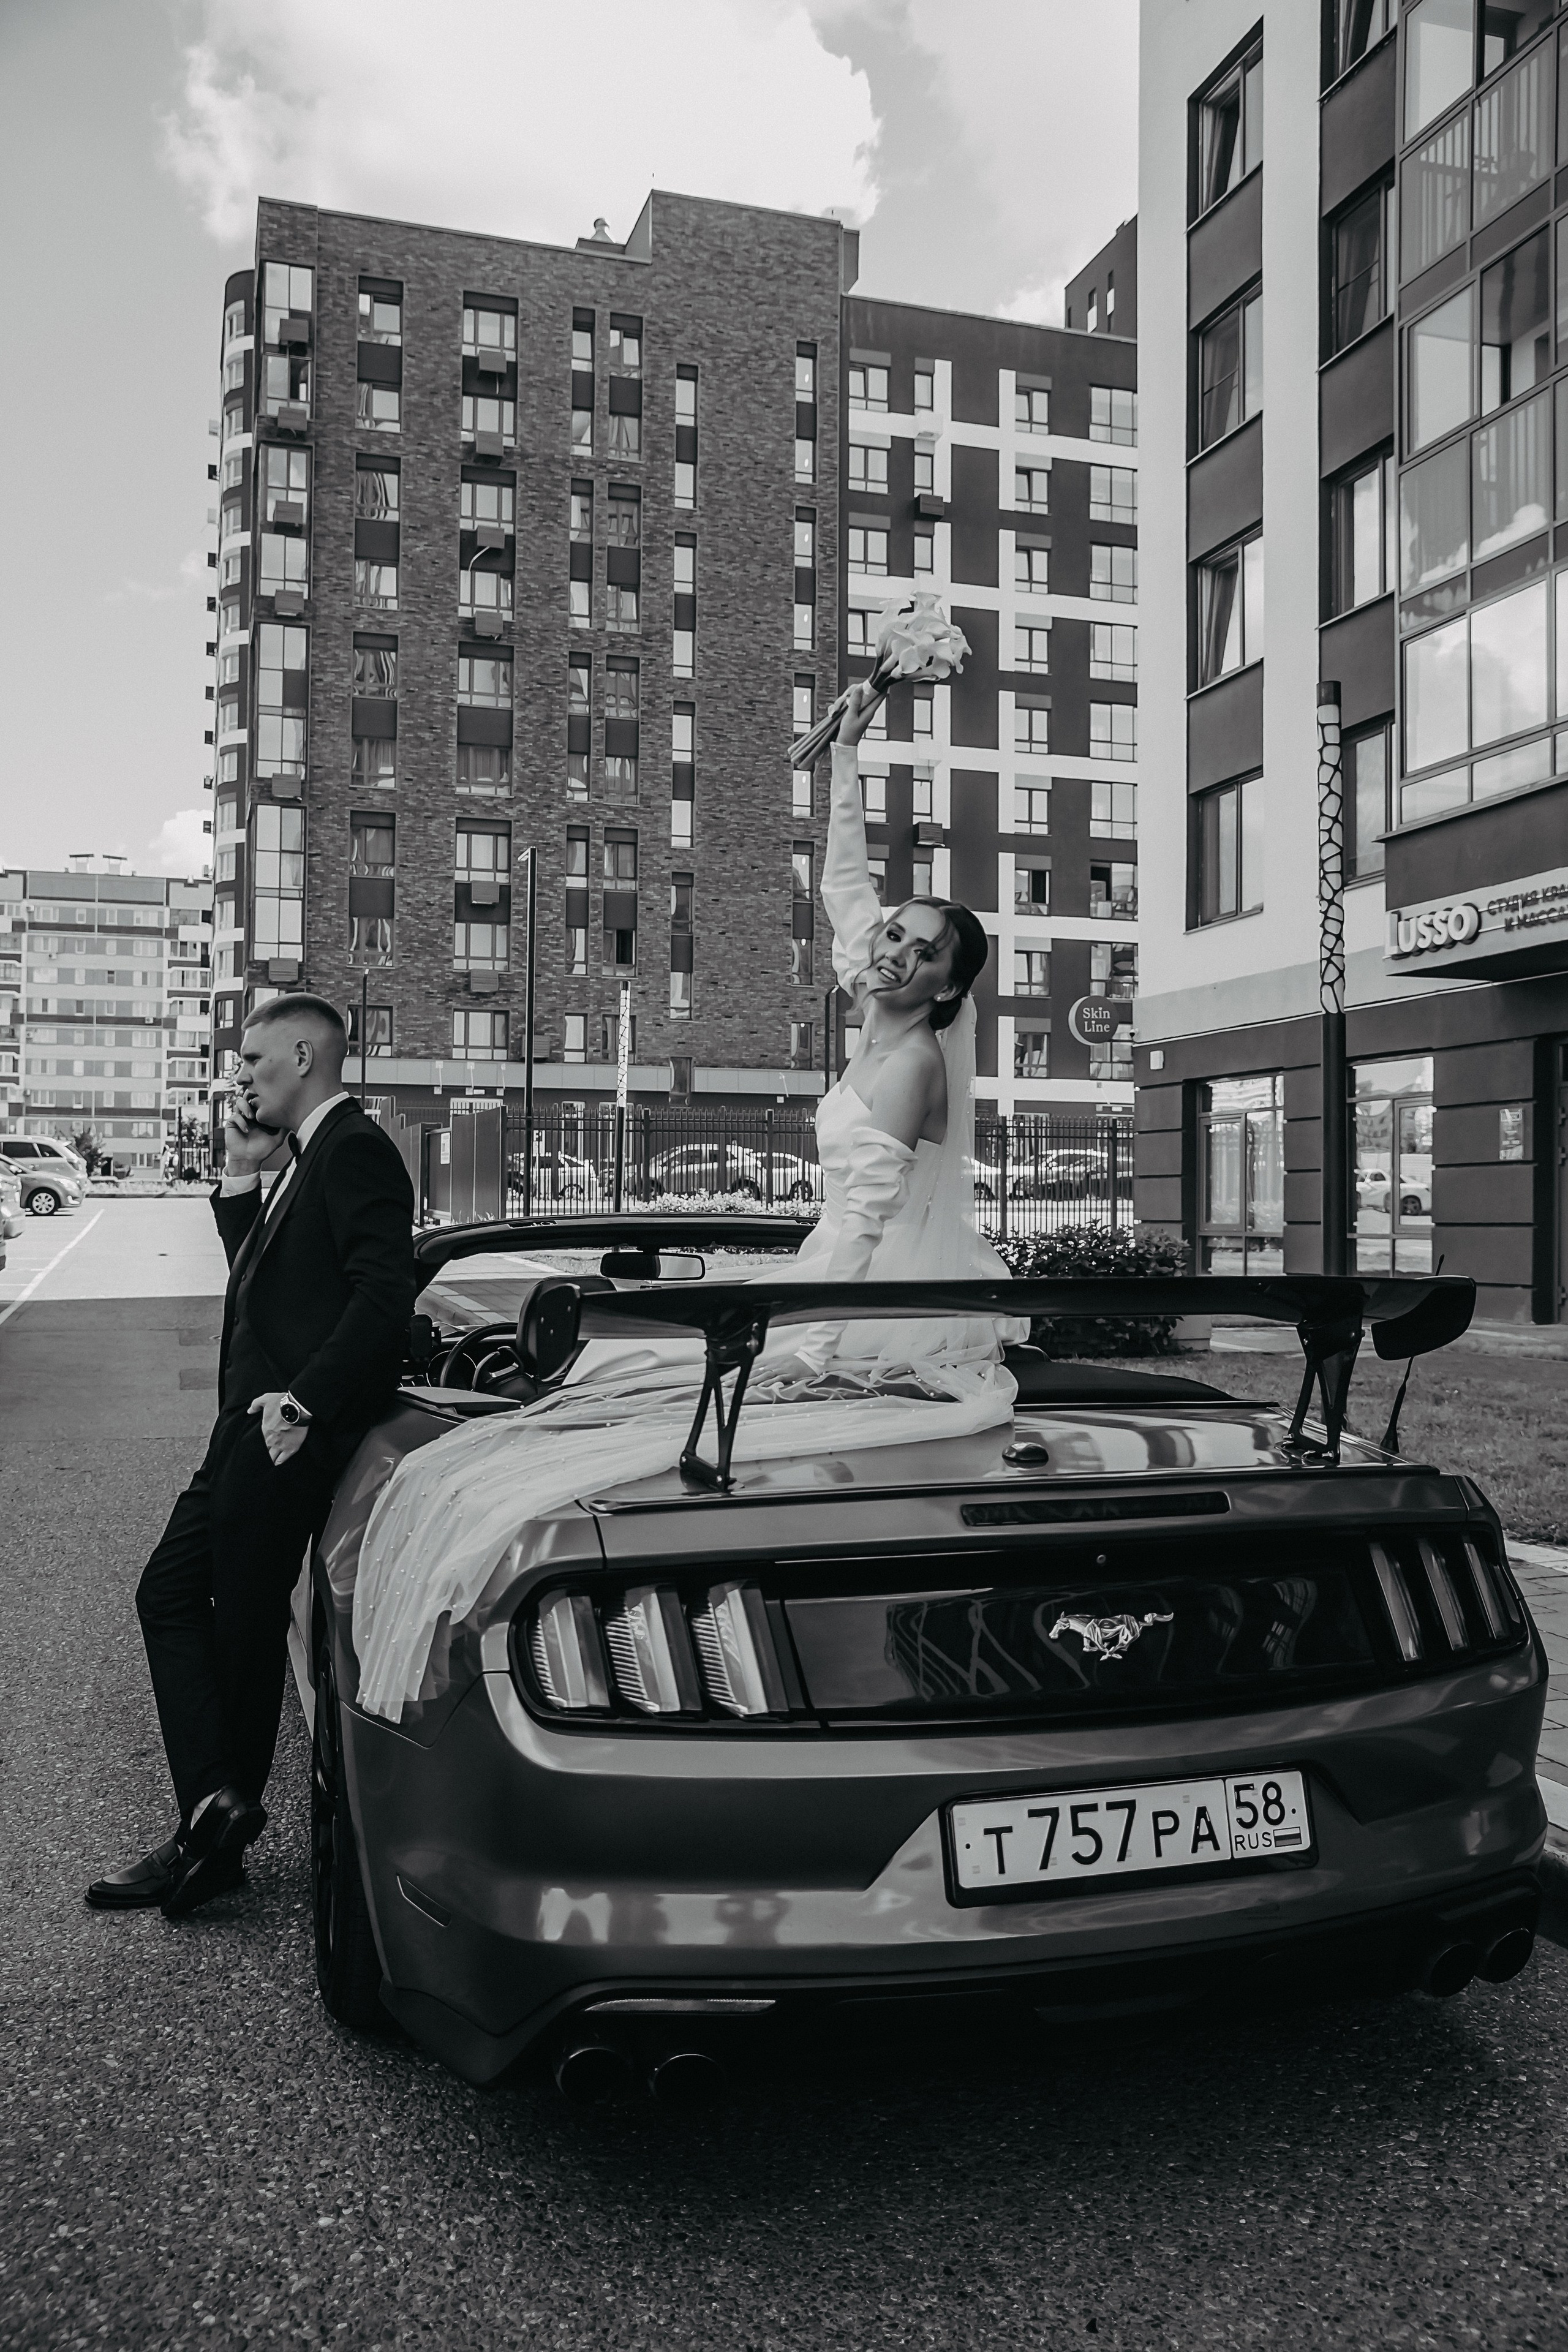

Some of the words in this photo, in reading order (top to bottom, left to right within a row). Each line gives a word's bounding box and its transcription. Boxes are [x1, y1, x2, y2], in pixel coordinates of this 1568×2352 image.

[1384, 905, 1479, 956] LUSSO
[1082, 1007, 1110, 1019] Skin
[1084, 1021, 1110, 1032] Line
[1234, 1781, 1286, 1829] 58
[1234, 1831, 1273, 1852] RUS
